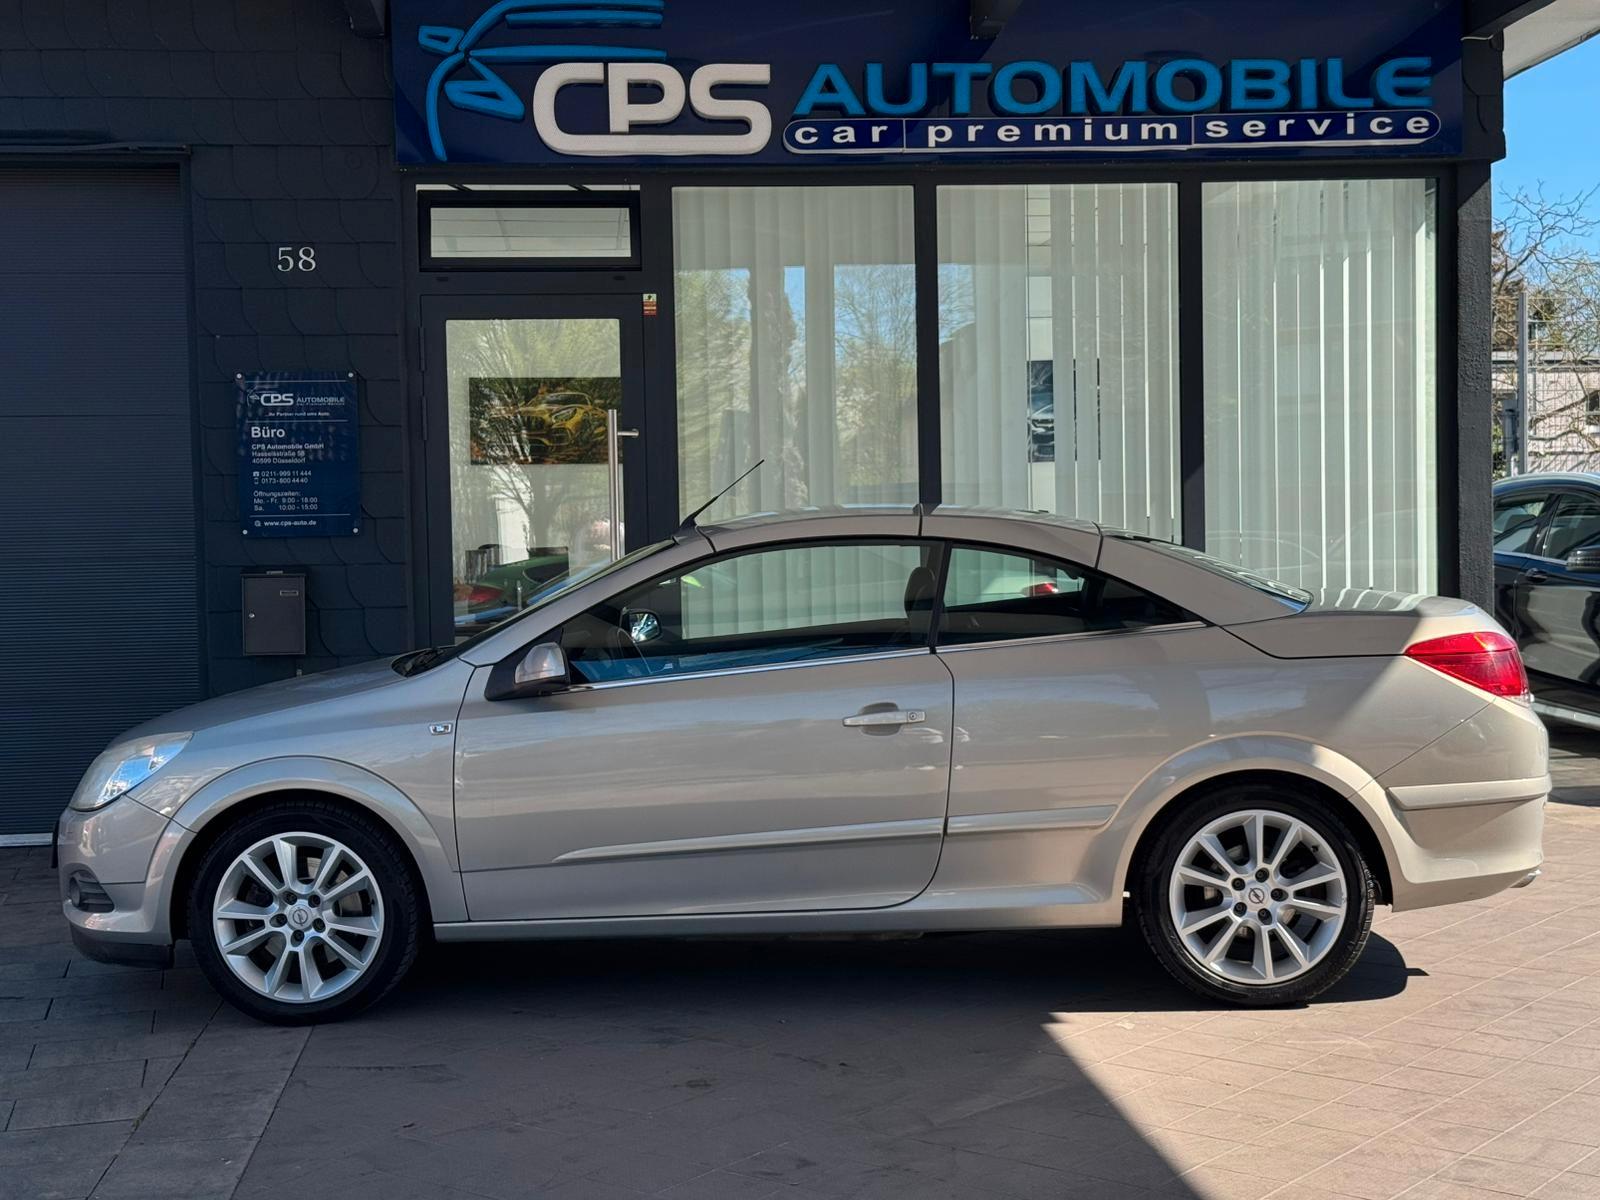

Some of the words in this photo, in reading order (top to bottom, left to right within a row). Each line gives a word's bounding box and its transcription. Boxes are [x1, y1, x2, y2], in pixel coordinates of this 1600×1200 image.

[533, 62, 771, 156] CPS
[793, 56, 1432, 116] AUTOMOBILE
[794, 125, 888, 144] car
[928, 119, 1178, 147] premium
[1206, 113, 1430, 138] service
[277, 246, 316, 272] 58
[260, 393, 294, 406] CPS
[251, 426, 285, 438] Büro
